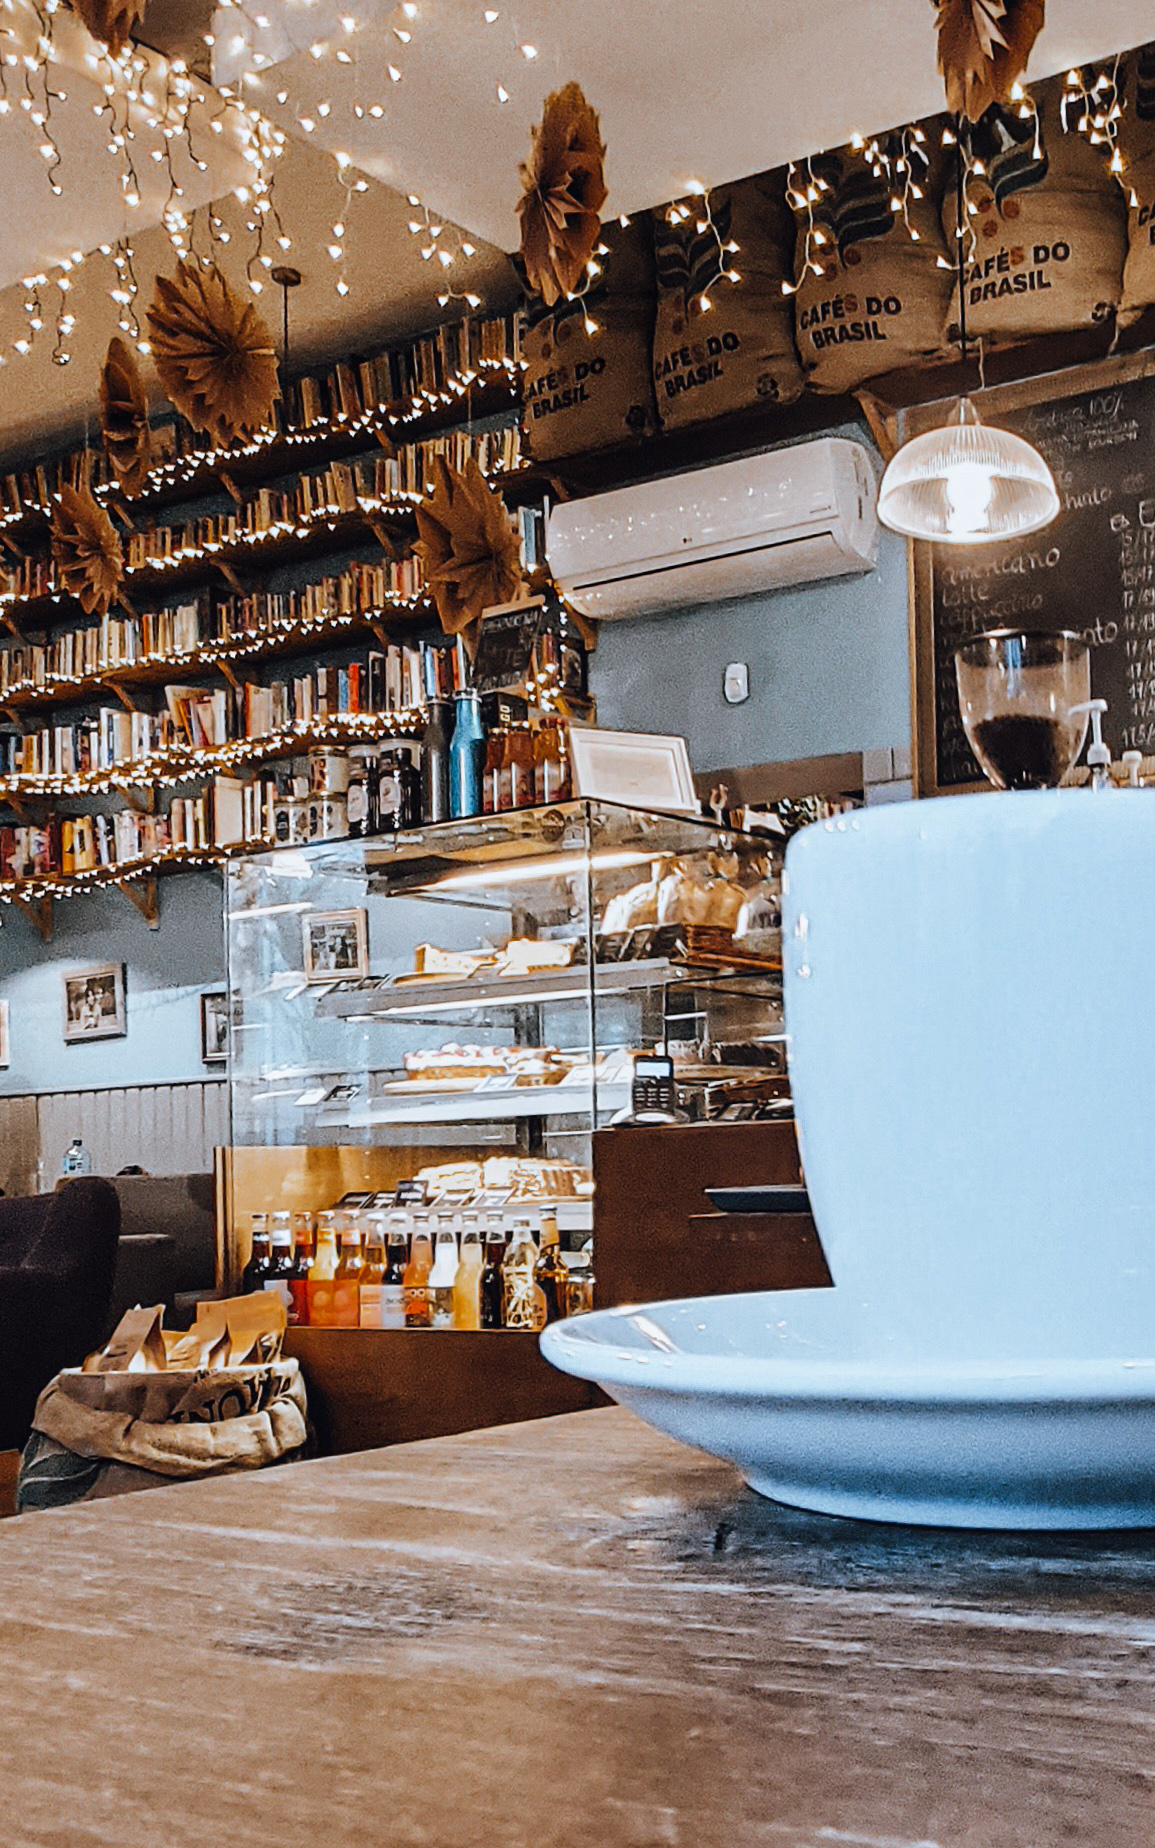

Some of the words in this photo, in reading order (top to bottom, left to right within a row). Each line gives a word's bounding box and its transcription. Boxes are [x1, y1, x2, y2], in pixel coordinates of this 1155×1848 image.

[1033, 241, 1070, 264] DO
[970, 269, 1052, 305] BRASIL
[866, 295, 902, 315] DO
[706, 332, 740, 356] DO
[812, 321, 887, 349] BRASIL
[574, 357, 606, 381] DO
[665, 361, 723, 398] BRASIL
[532, 385, 590, 419] BRASIL
